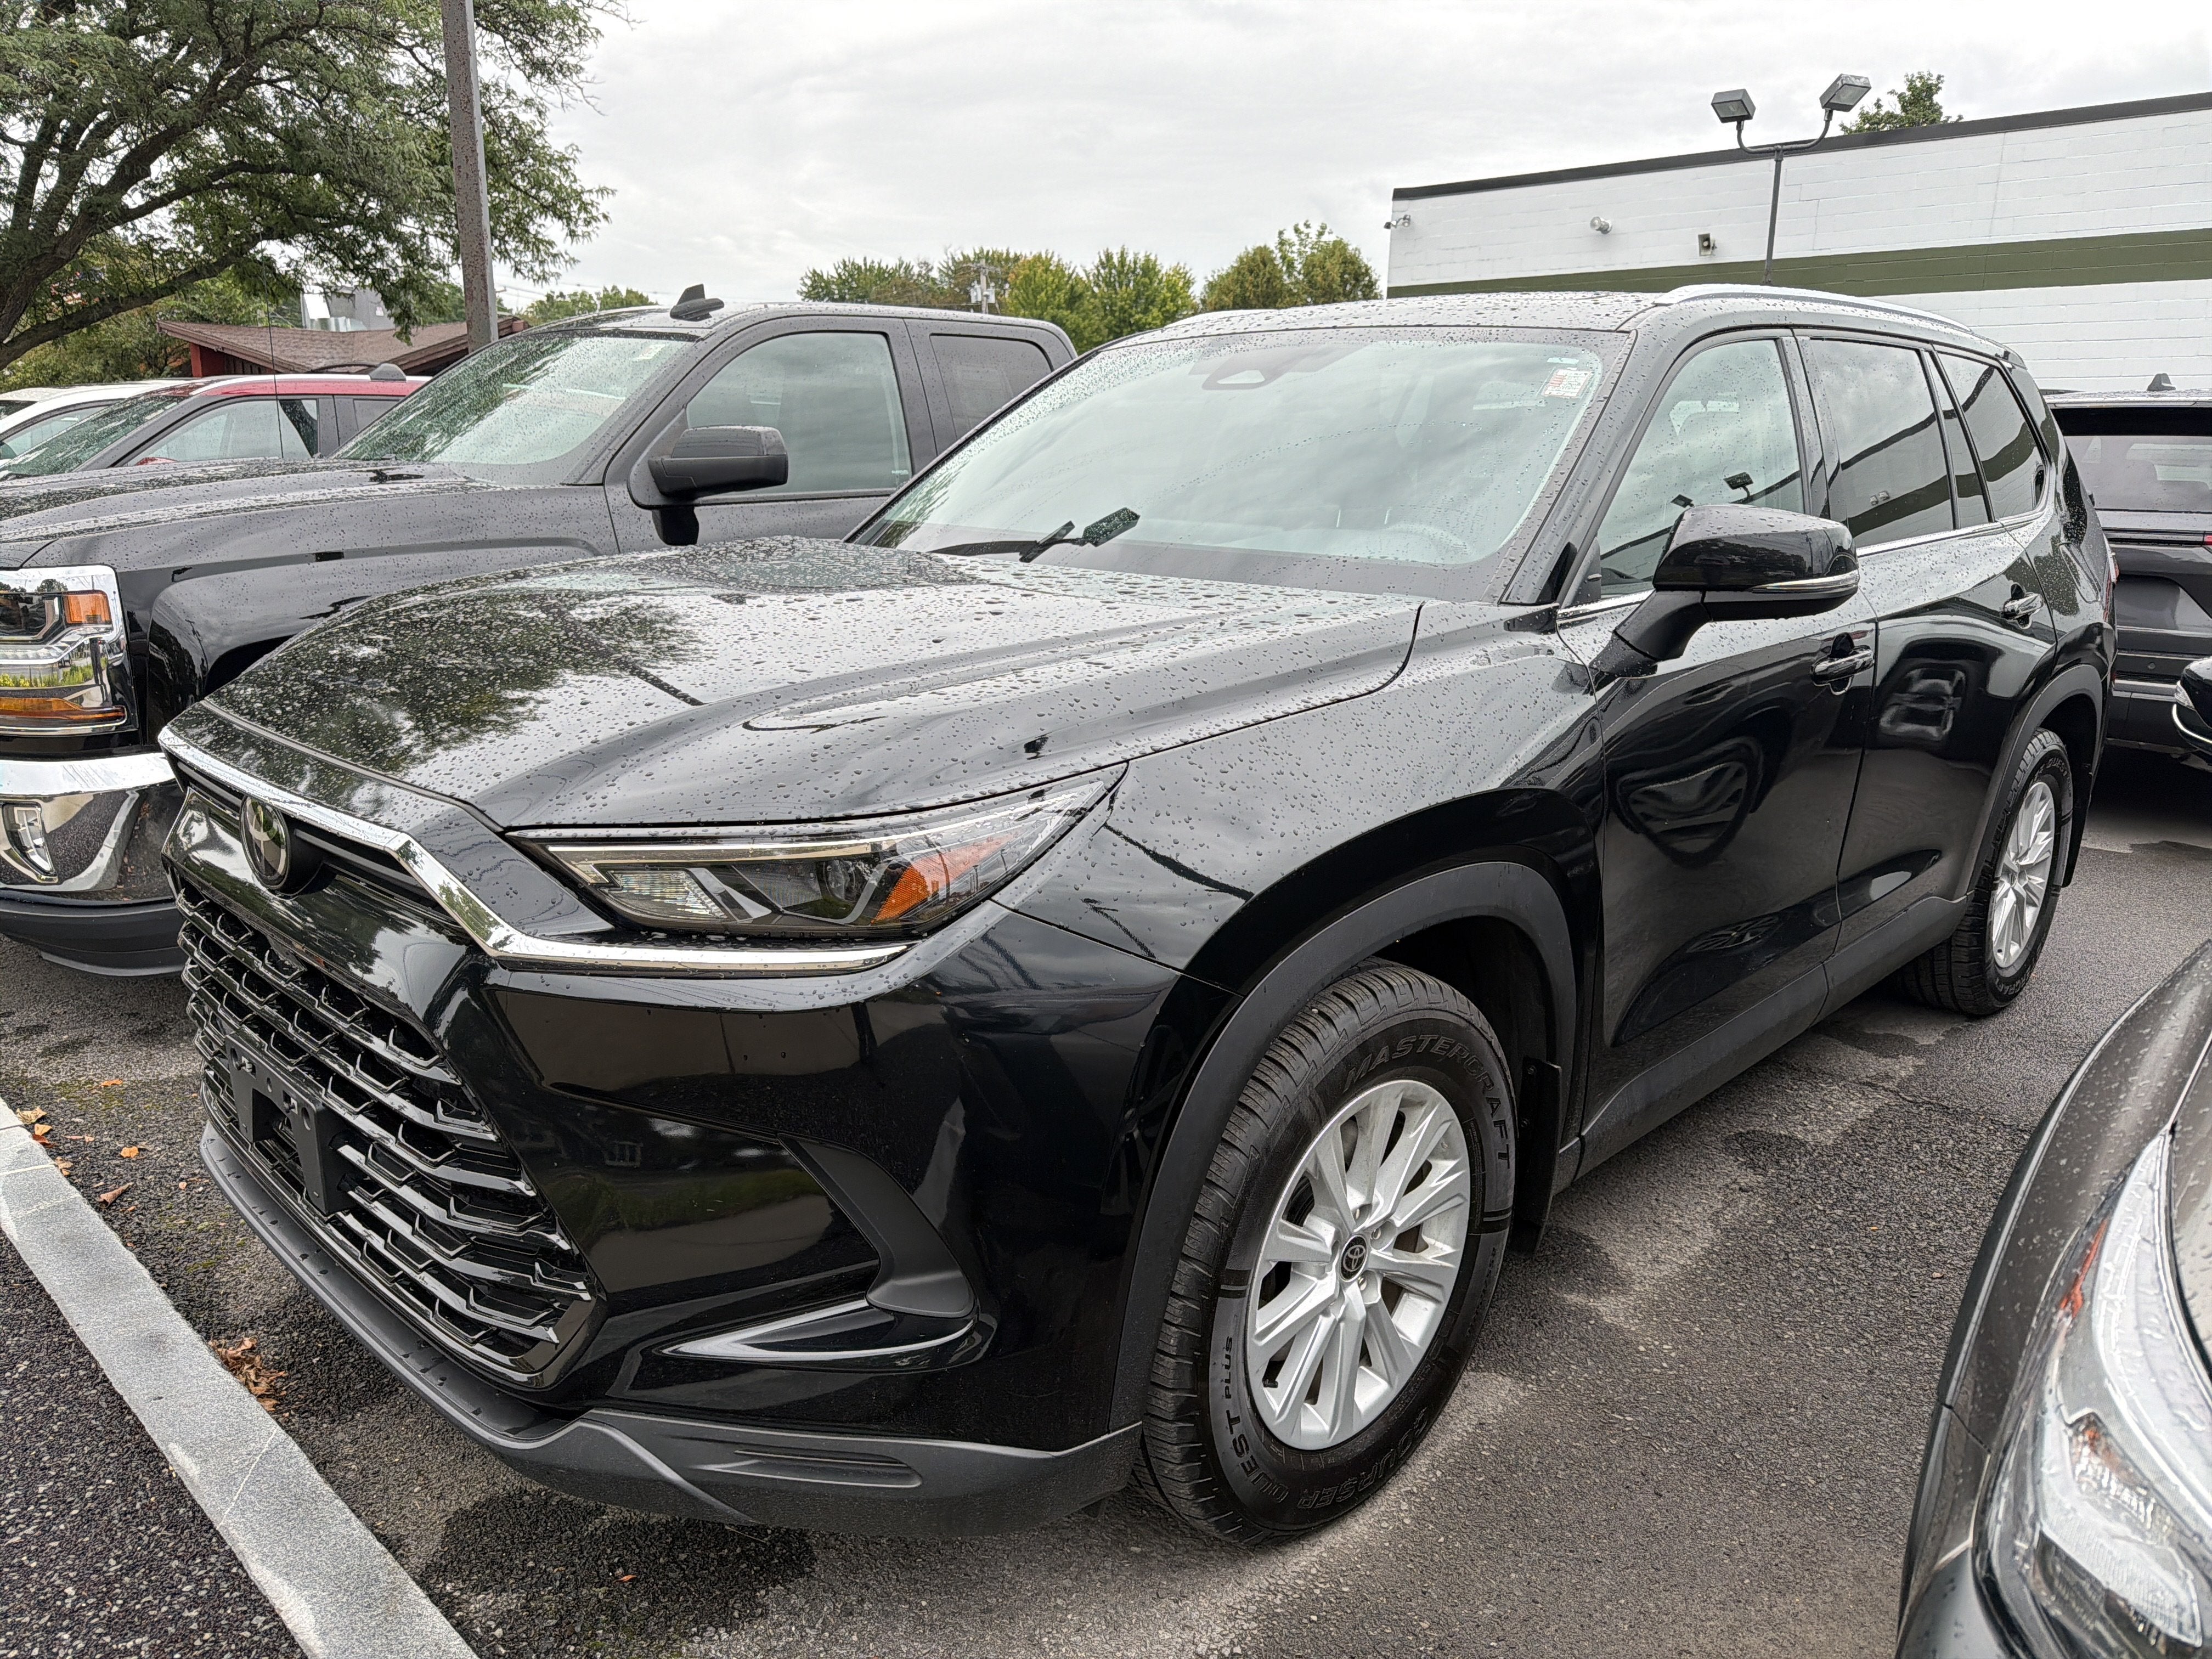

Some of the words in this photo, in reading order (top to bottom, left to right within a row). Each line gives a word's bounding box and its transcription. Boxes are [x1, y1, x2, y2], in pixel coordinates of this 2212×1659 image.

[1344, 1034, 1510, 1169] MASTERCRAFT
[1224, 1336, 1233, 1399] PLUS
[1226, 1410, 1289, 1503] QUEST
